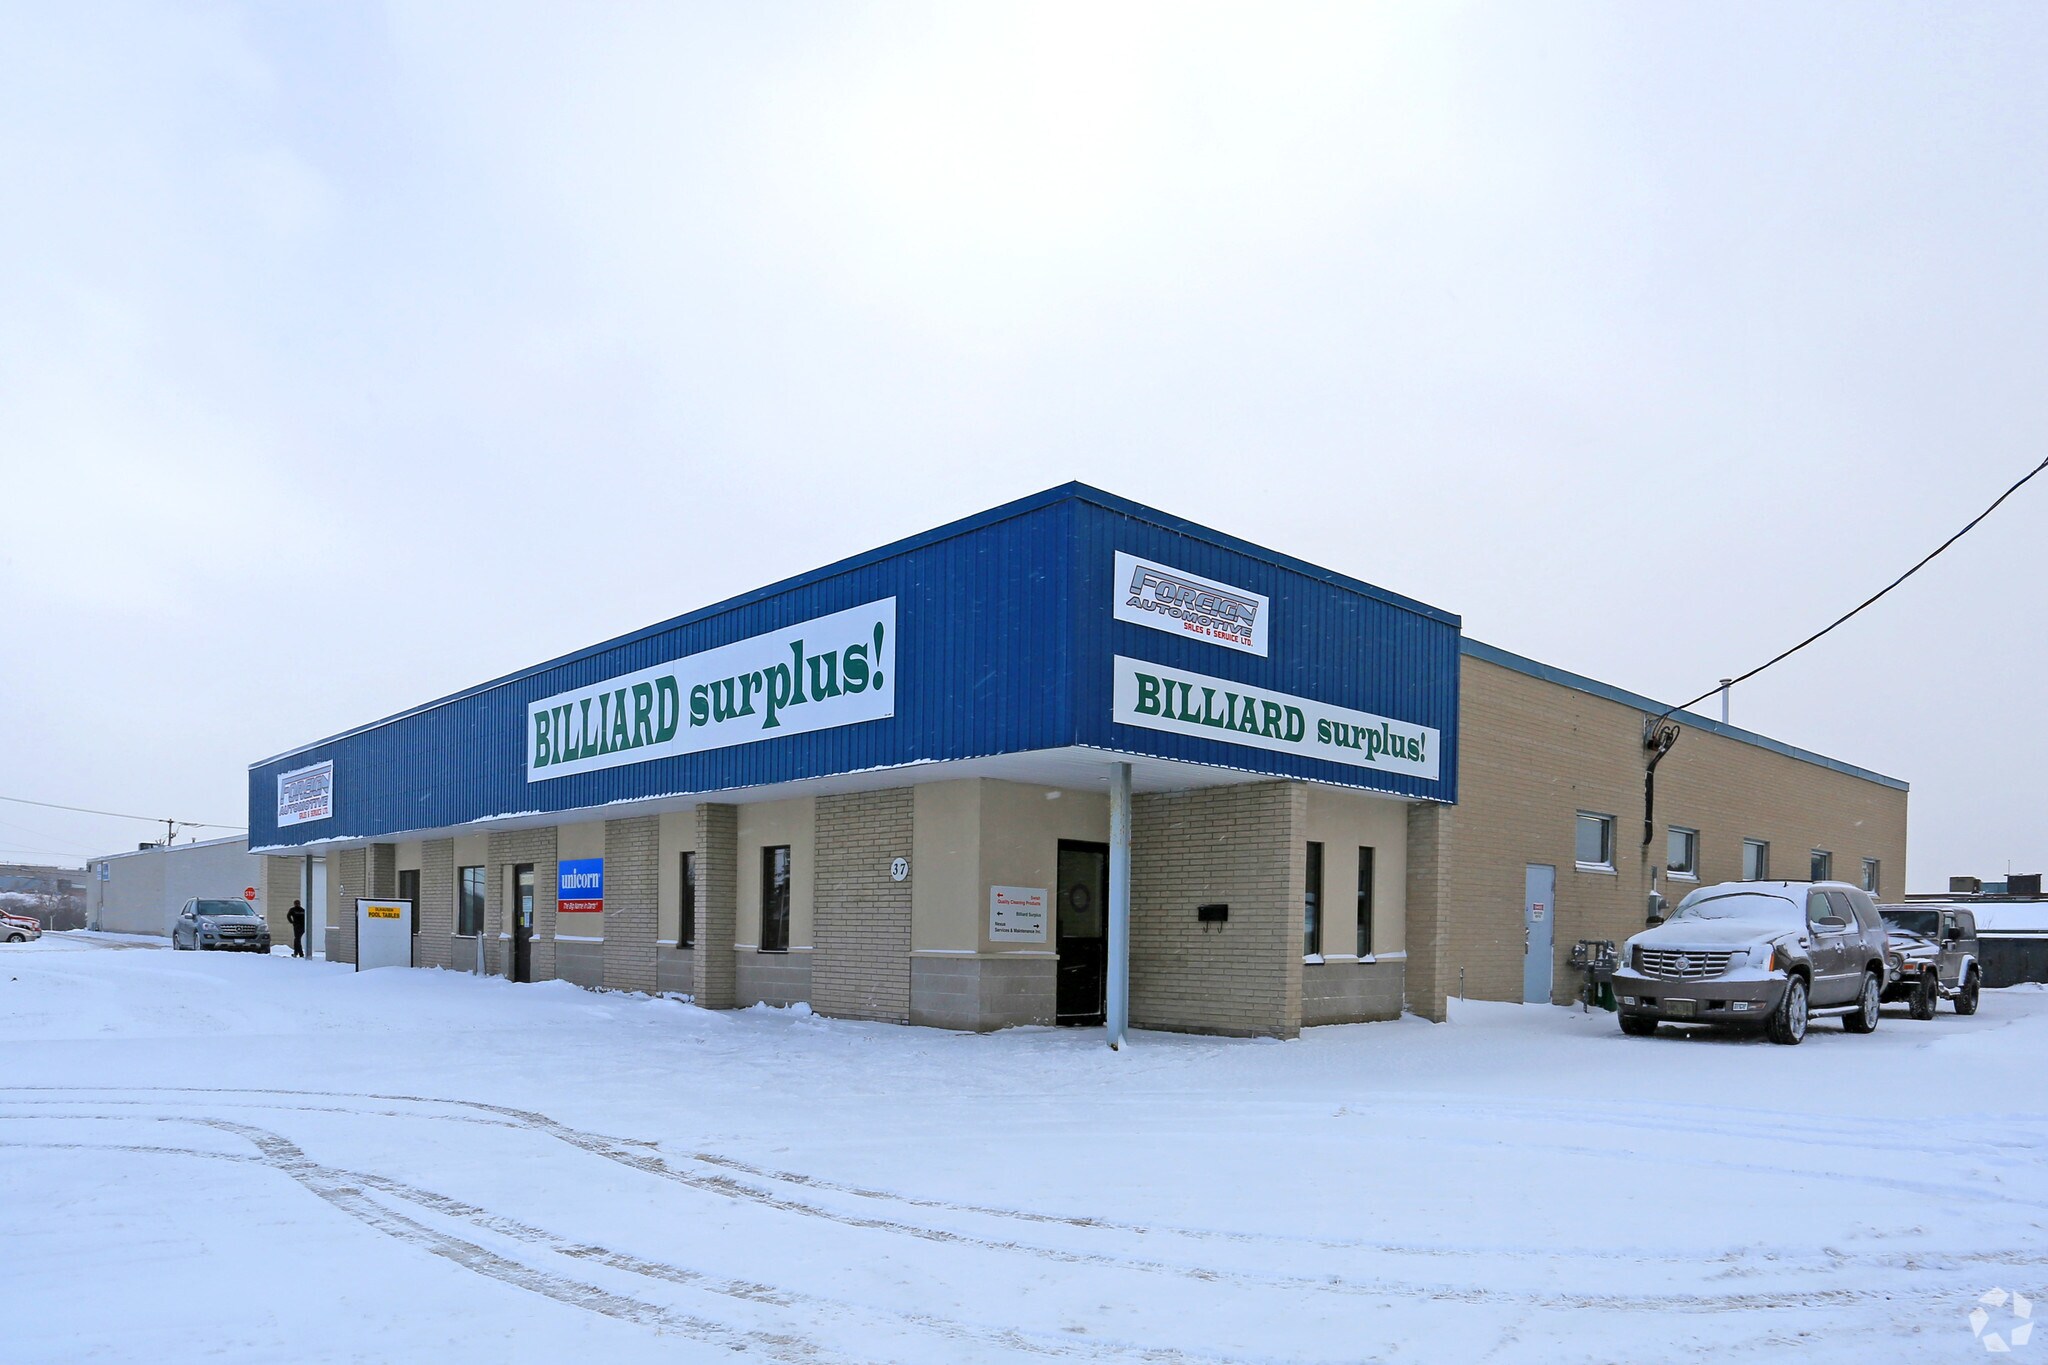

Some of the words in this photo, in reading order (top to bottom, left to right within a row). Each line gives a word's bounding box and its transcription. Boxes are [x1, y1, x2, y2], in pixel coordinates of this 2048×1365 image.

[1129, 564, 1259, 626] FOREIGN
[1126, 596, 1252, 638] AUTOMOTIVE
[1184, 622, 1203, 633] SALES
[1206, 628, 1211, 636] &
[1213, 630, 1239, 642] SERVICE
[1240, 638, 1253, 647] LTD.
[532, 674, 680, 769] BILLIARD
[689, 621, 885, 730] surplus!
[1134, 672, 1306, 743] BILLIARD
[1317, 717, 1426, 762] surplus!
[279, 795, 329, 816] AUTOMOTIVE
[280, 765, 331, 806] FOREIGN
[561, 868, 600, 890] unicorn
[892, 863, 906, 875] 37
